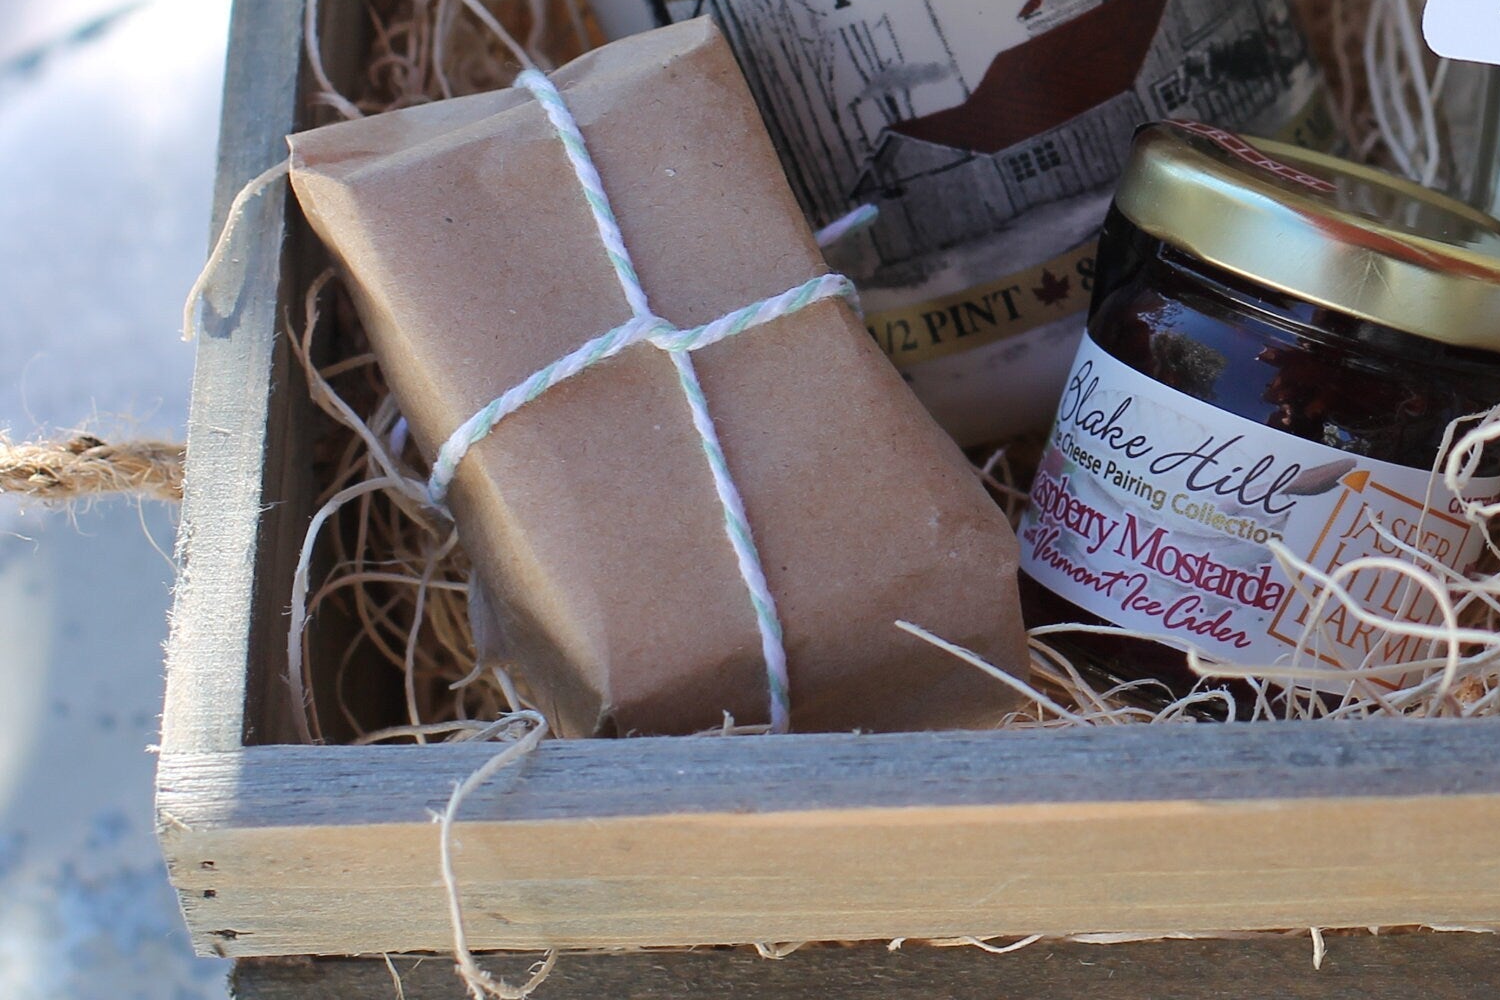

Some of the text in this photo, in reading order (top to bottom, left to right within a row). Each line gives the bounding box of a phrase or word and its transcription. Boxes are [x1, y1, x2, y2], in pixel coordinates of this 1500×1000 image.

[922, 285, 1021, 344] PINT
[1061, 360, 1302, 514] Blake Hill
[1061, 433, 1102, 475] Cheese
[1103, 460, 1168, 511] Pairing
[1170, 488, 1283, 545] Collection
[1032, 527, 1129, 597] Vermont
[1122, 572, 1165, 619] Ice
[1162, 597, 1253, 649] Cider
[1114, 512, 1285, 613] Mostarda
